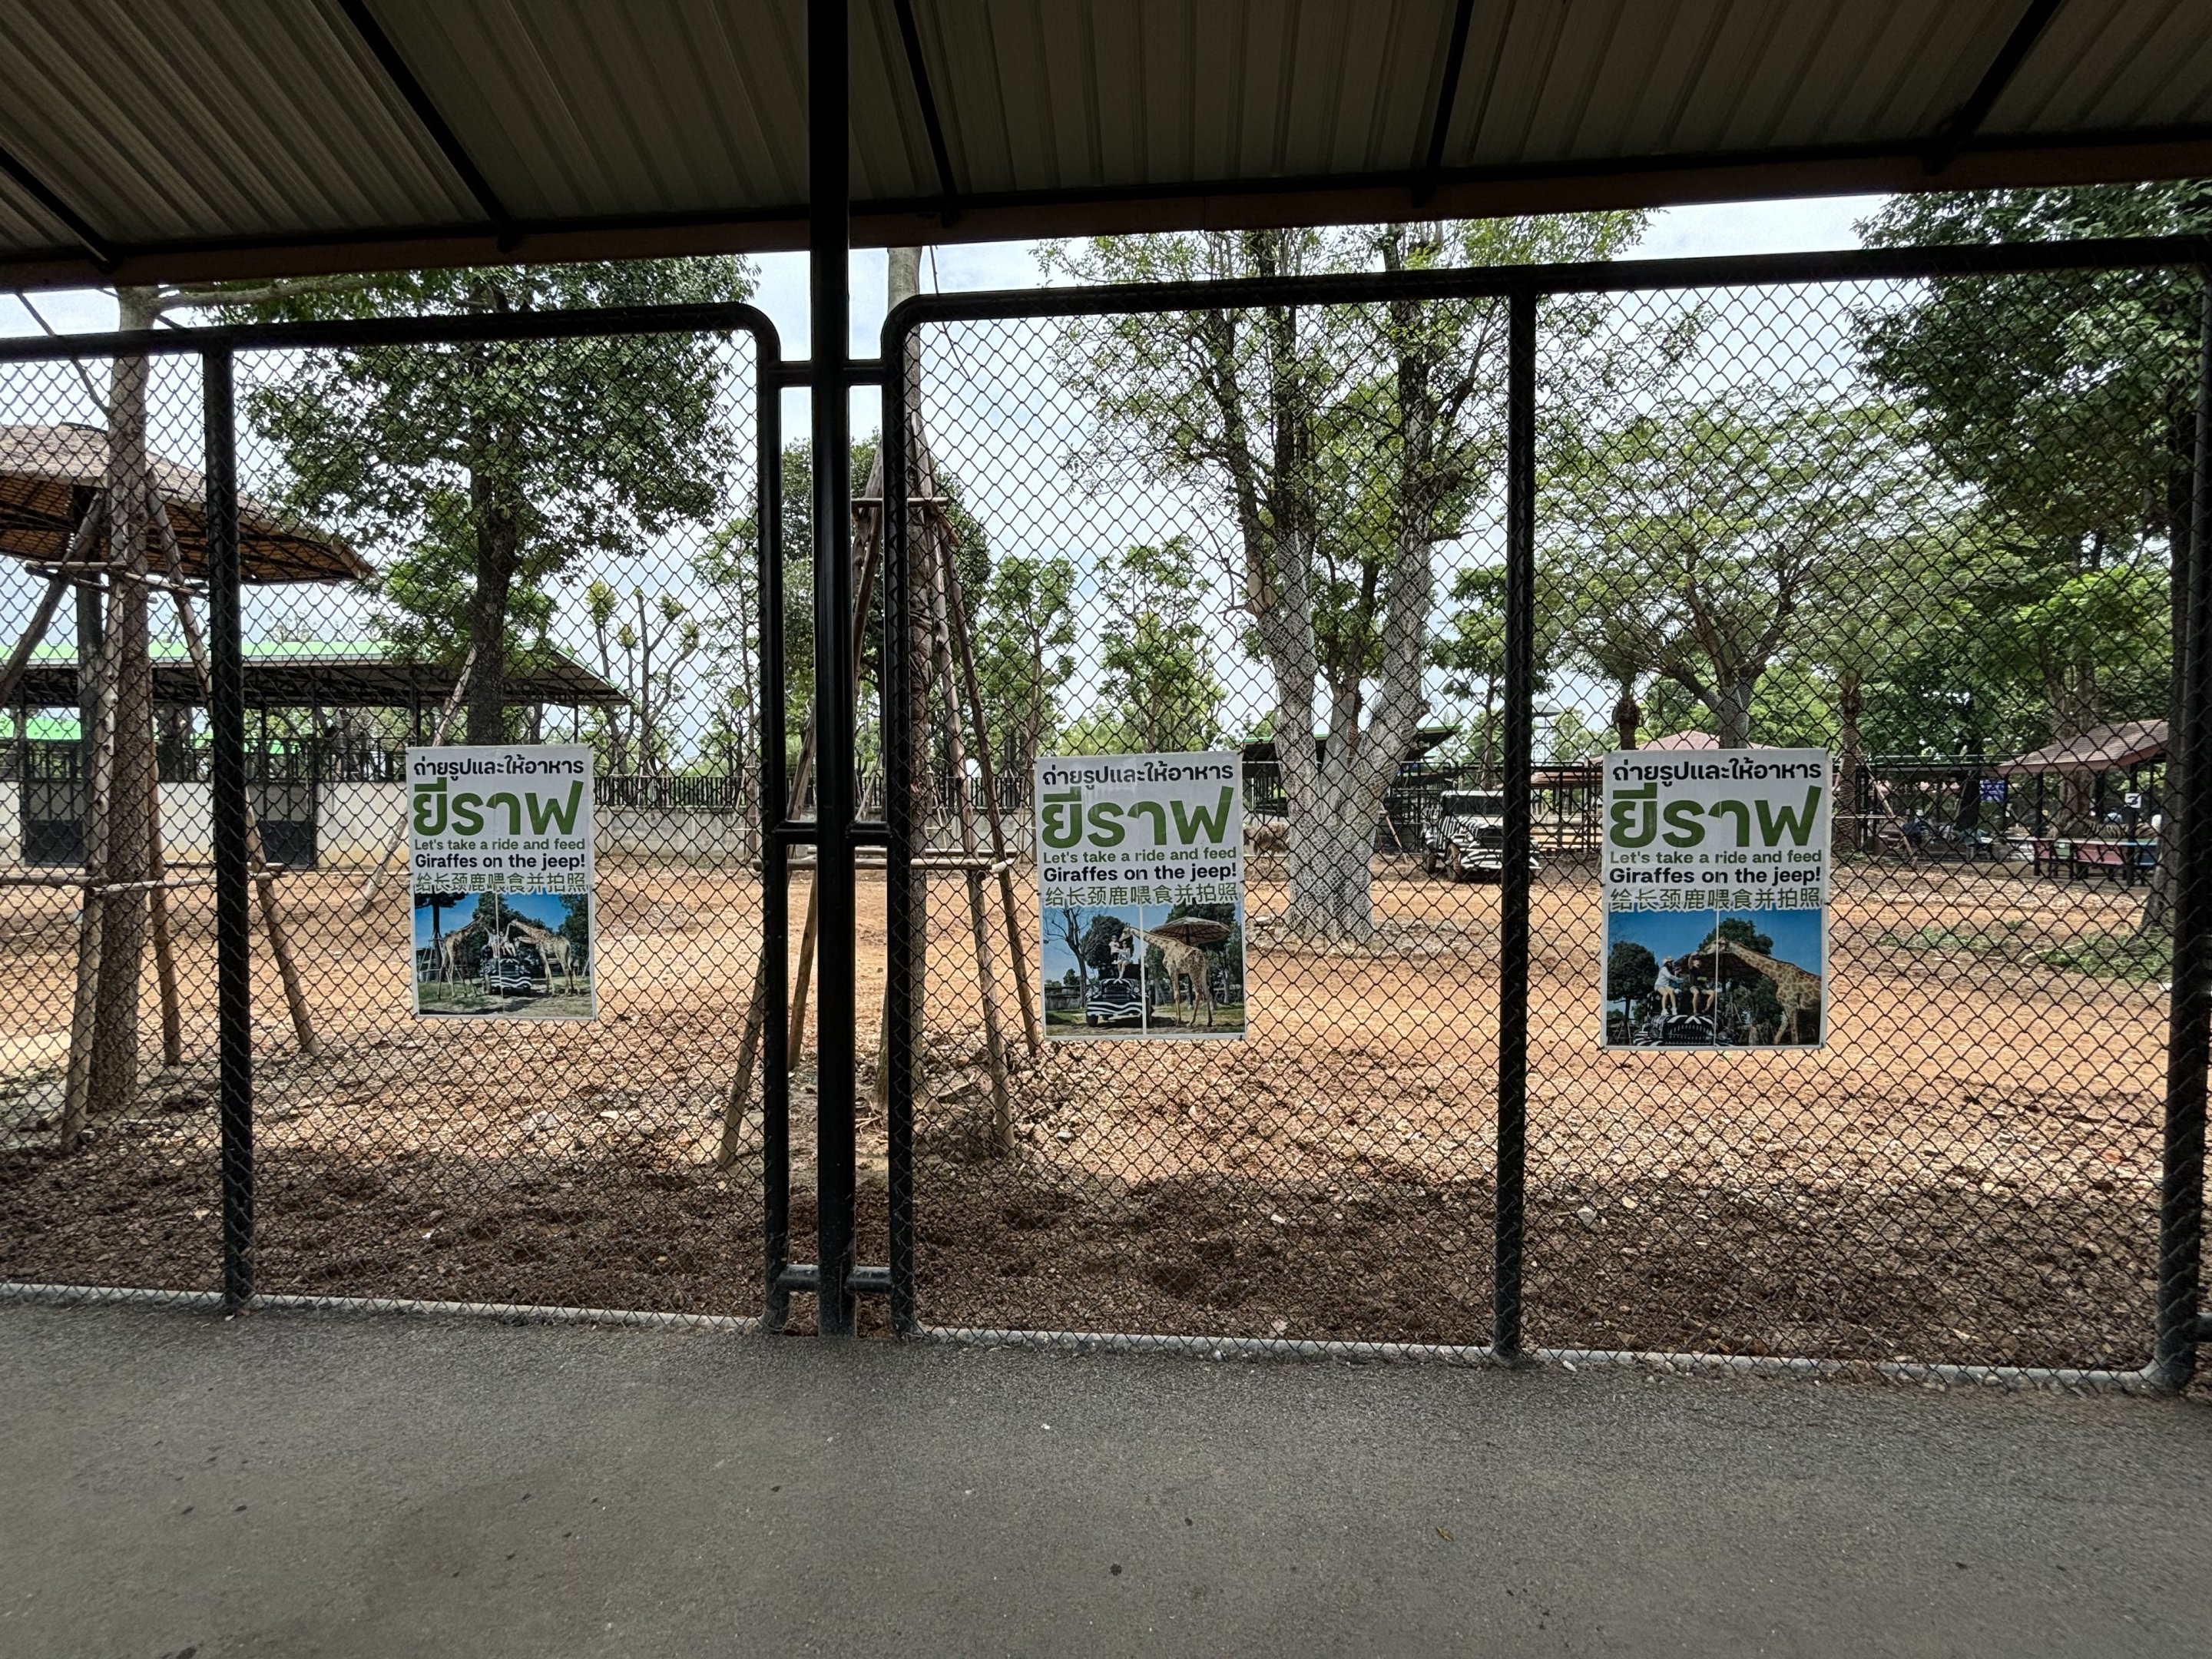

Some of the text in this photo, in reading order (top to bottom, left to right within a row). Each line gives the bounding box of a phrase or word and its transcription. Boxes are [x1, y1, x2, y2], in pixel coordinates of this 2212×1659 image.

[414, 754, 584, 781] ถ่ายรูปและให้อาหาร
[1043, 760, 1233, 790] ถ่ายรูปและให้อาหาร
[1613, 757, 1822, 786] ถ่ายรูปและให้อาหาร
[413, 777, 584, 836] ยีราฟ
[1041, 786, 1234, 849] ยีราฟ
[1610, 782, 1822, 848] ยีราฟ
[415, 839, 585, 850] Let's take a ride and feed
[1044, 846, 1237, 864] Let's take a ride and feed
[415, 853, 585, 871] Giraffes on the jeep!
[1610, 849, 1822, 864] Let's take a ride and feed
[416, 873, 586, 893] 给长颈鹿喂食并拍照
[1044, 863, 1237, 882] Giraffes on the jeep!
[1609, 867, 1821, 886] Giraffes on the jeep!
[1045, 882, 1238, 906] 给长颈鹿喂食并拍照
[1611, 887, 1820, 910] 给长颈鹿喂食并拍照
